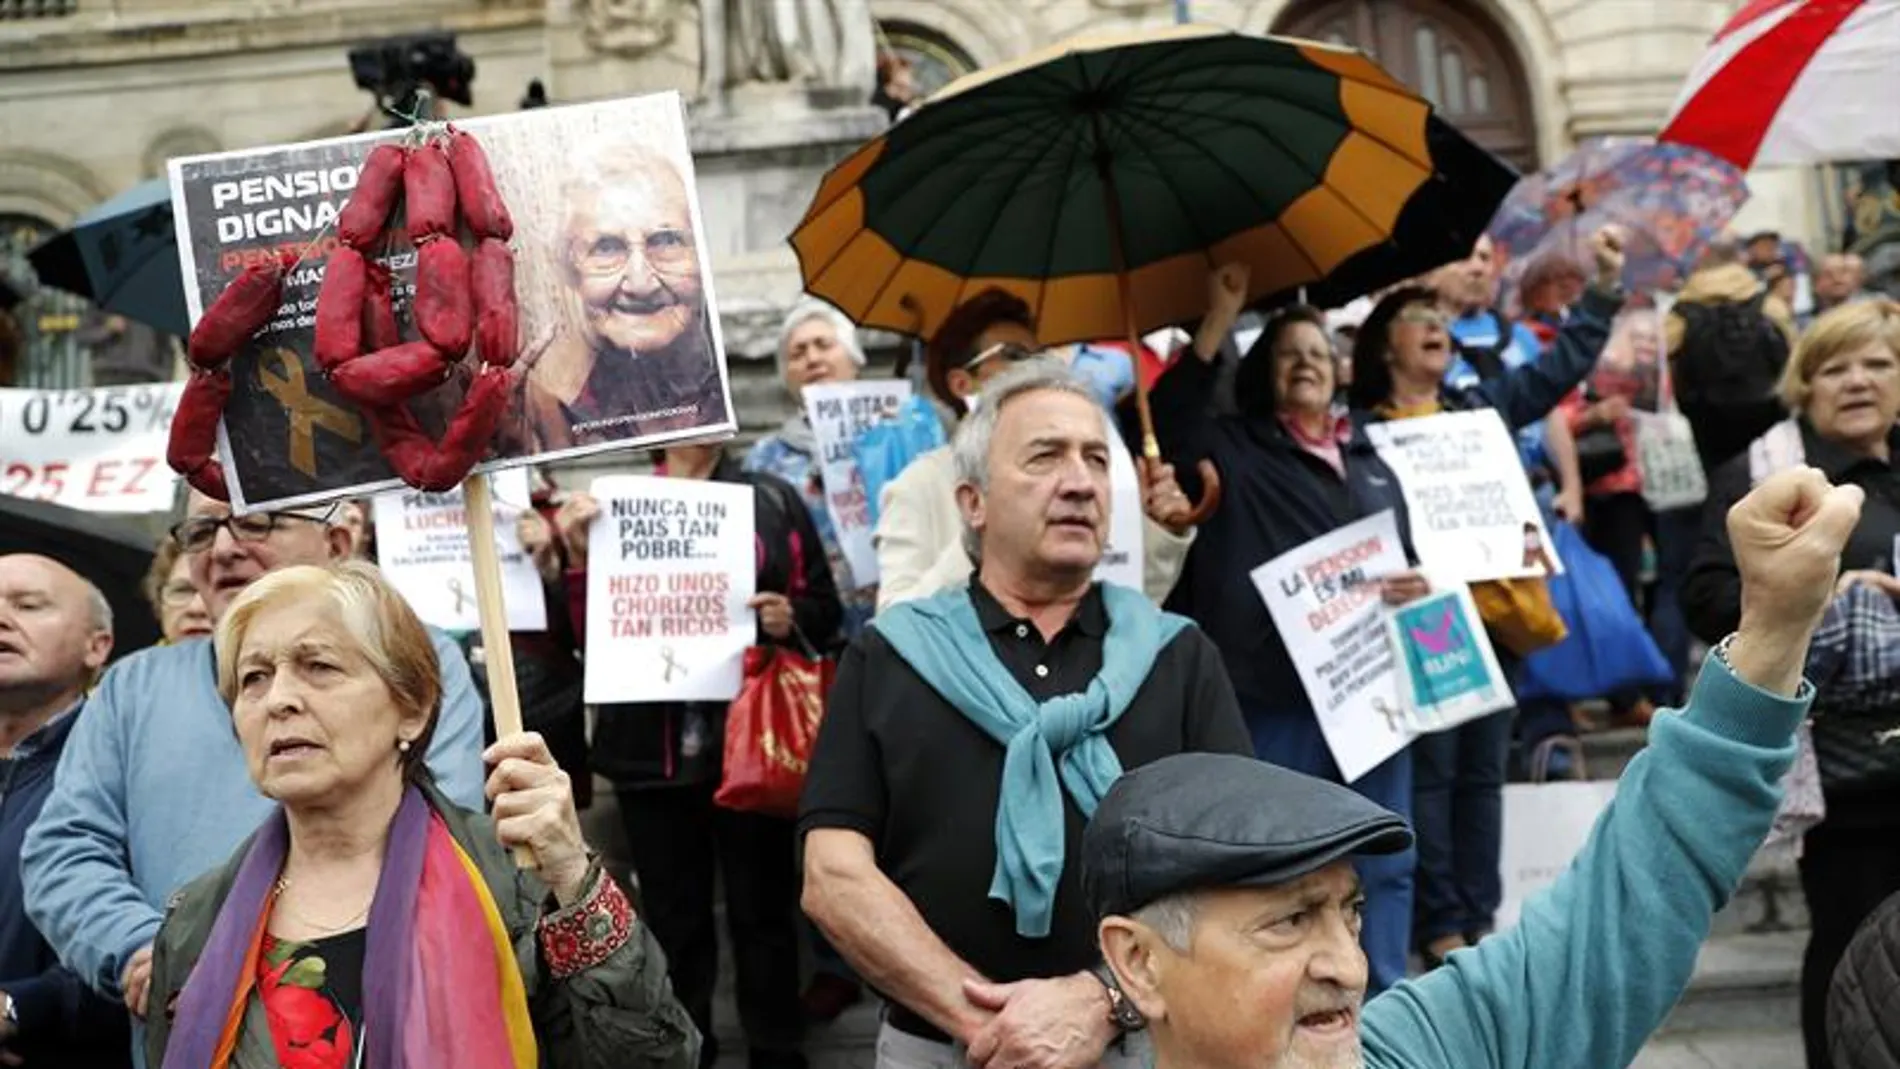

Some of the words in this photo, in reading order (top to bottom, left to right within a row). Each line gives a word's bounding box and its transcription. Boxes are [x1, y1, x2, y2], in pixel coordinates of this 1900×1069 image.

[212, 163, 364, 209] PENSIO
[217, 199, 349, 243] DIGNA
[86, 456, 157, 497] EZ
[611, 498, 688, 517] NUNCA
[697, 501, 727, 519] UN
[619, 518, 669, 539] PAIS
[678, 518, 719, 538] TAN
[609, 574, 660, 595] HIZO
[668, 572, 729, 593] UNOS
[1280, 573, 1305, 598] LA
[612, 595, 726, 616] CHORIZOS
[610, 617, 652, 638] TAN
[661, 616, 729, 637] RICOS
